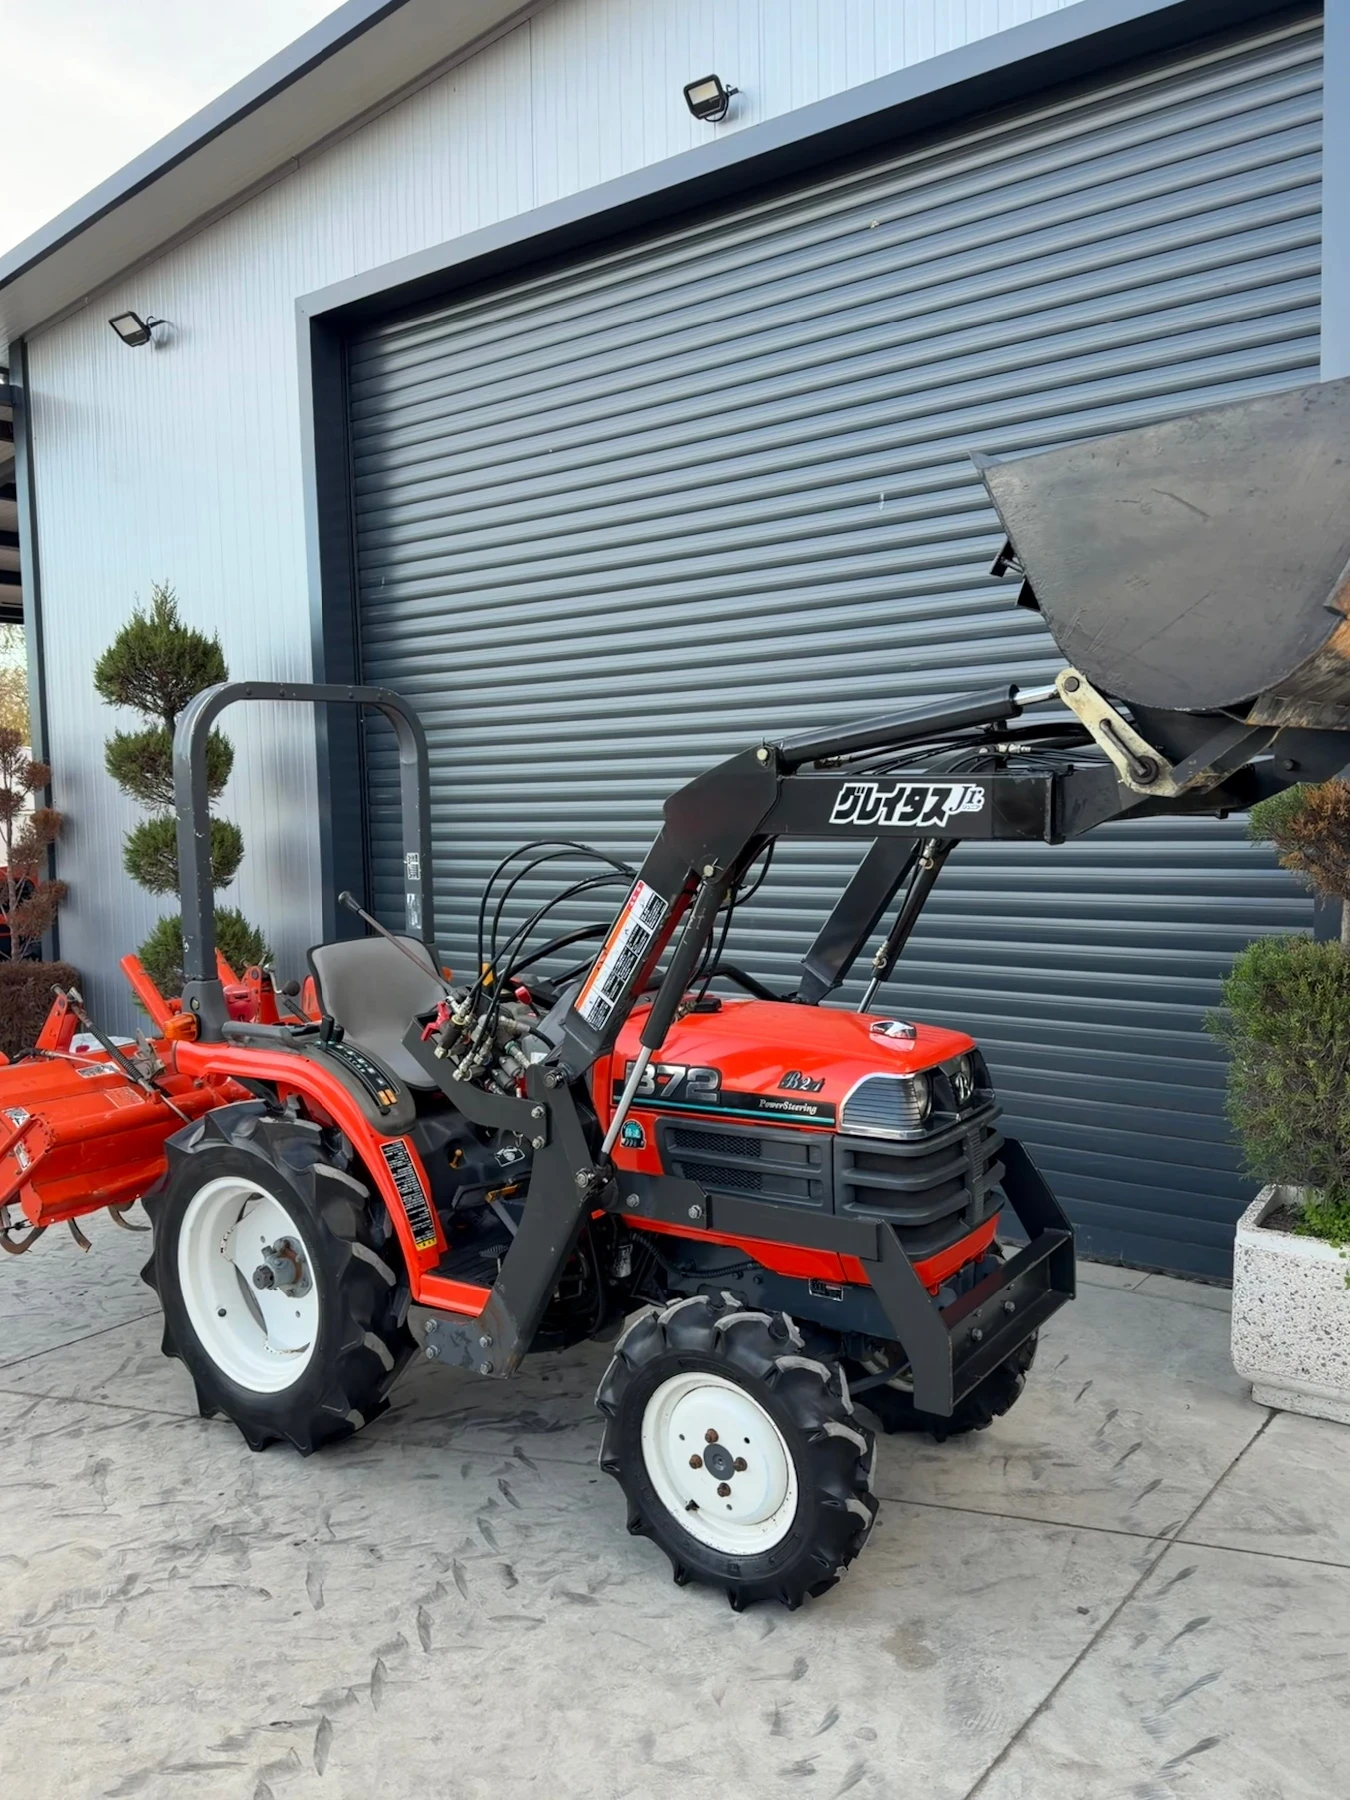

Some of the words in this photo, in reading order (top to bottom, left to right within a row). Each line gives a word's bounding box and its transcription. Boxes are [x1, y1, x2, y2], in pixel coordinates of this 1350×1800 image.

[831, 784, 953, 825] グレイタス
